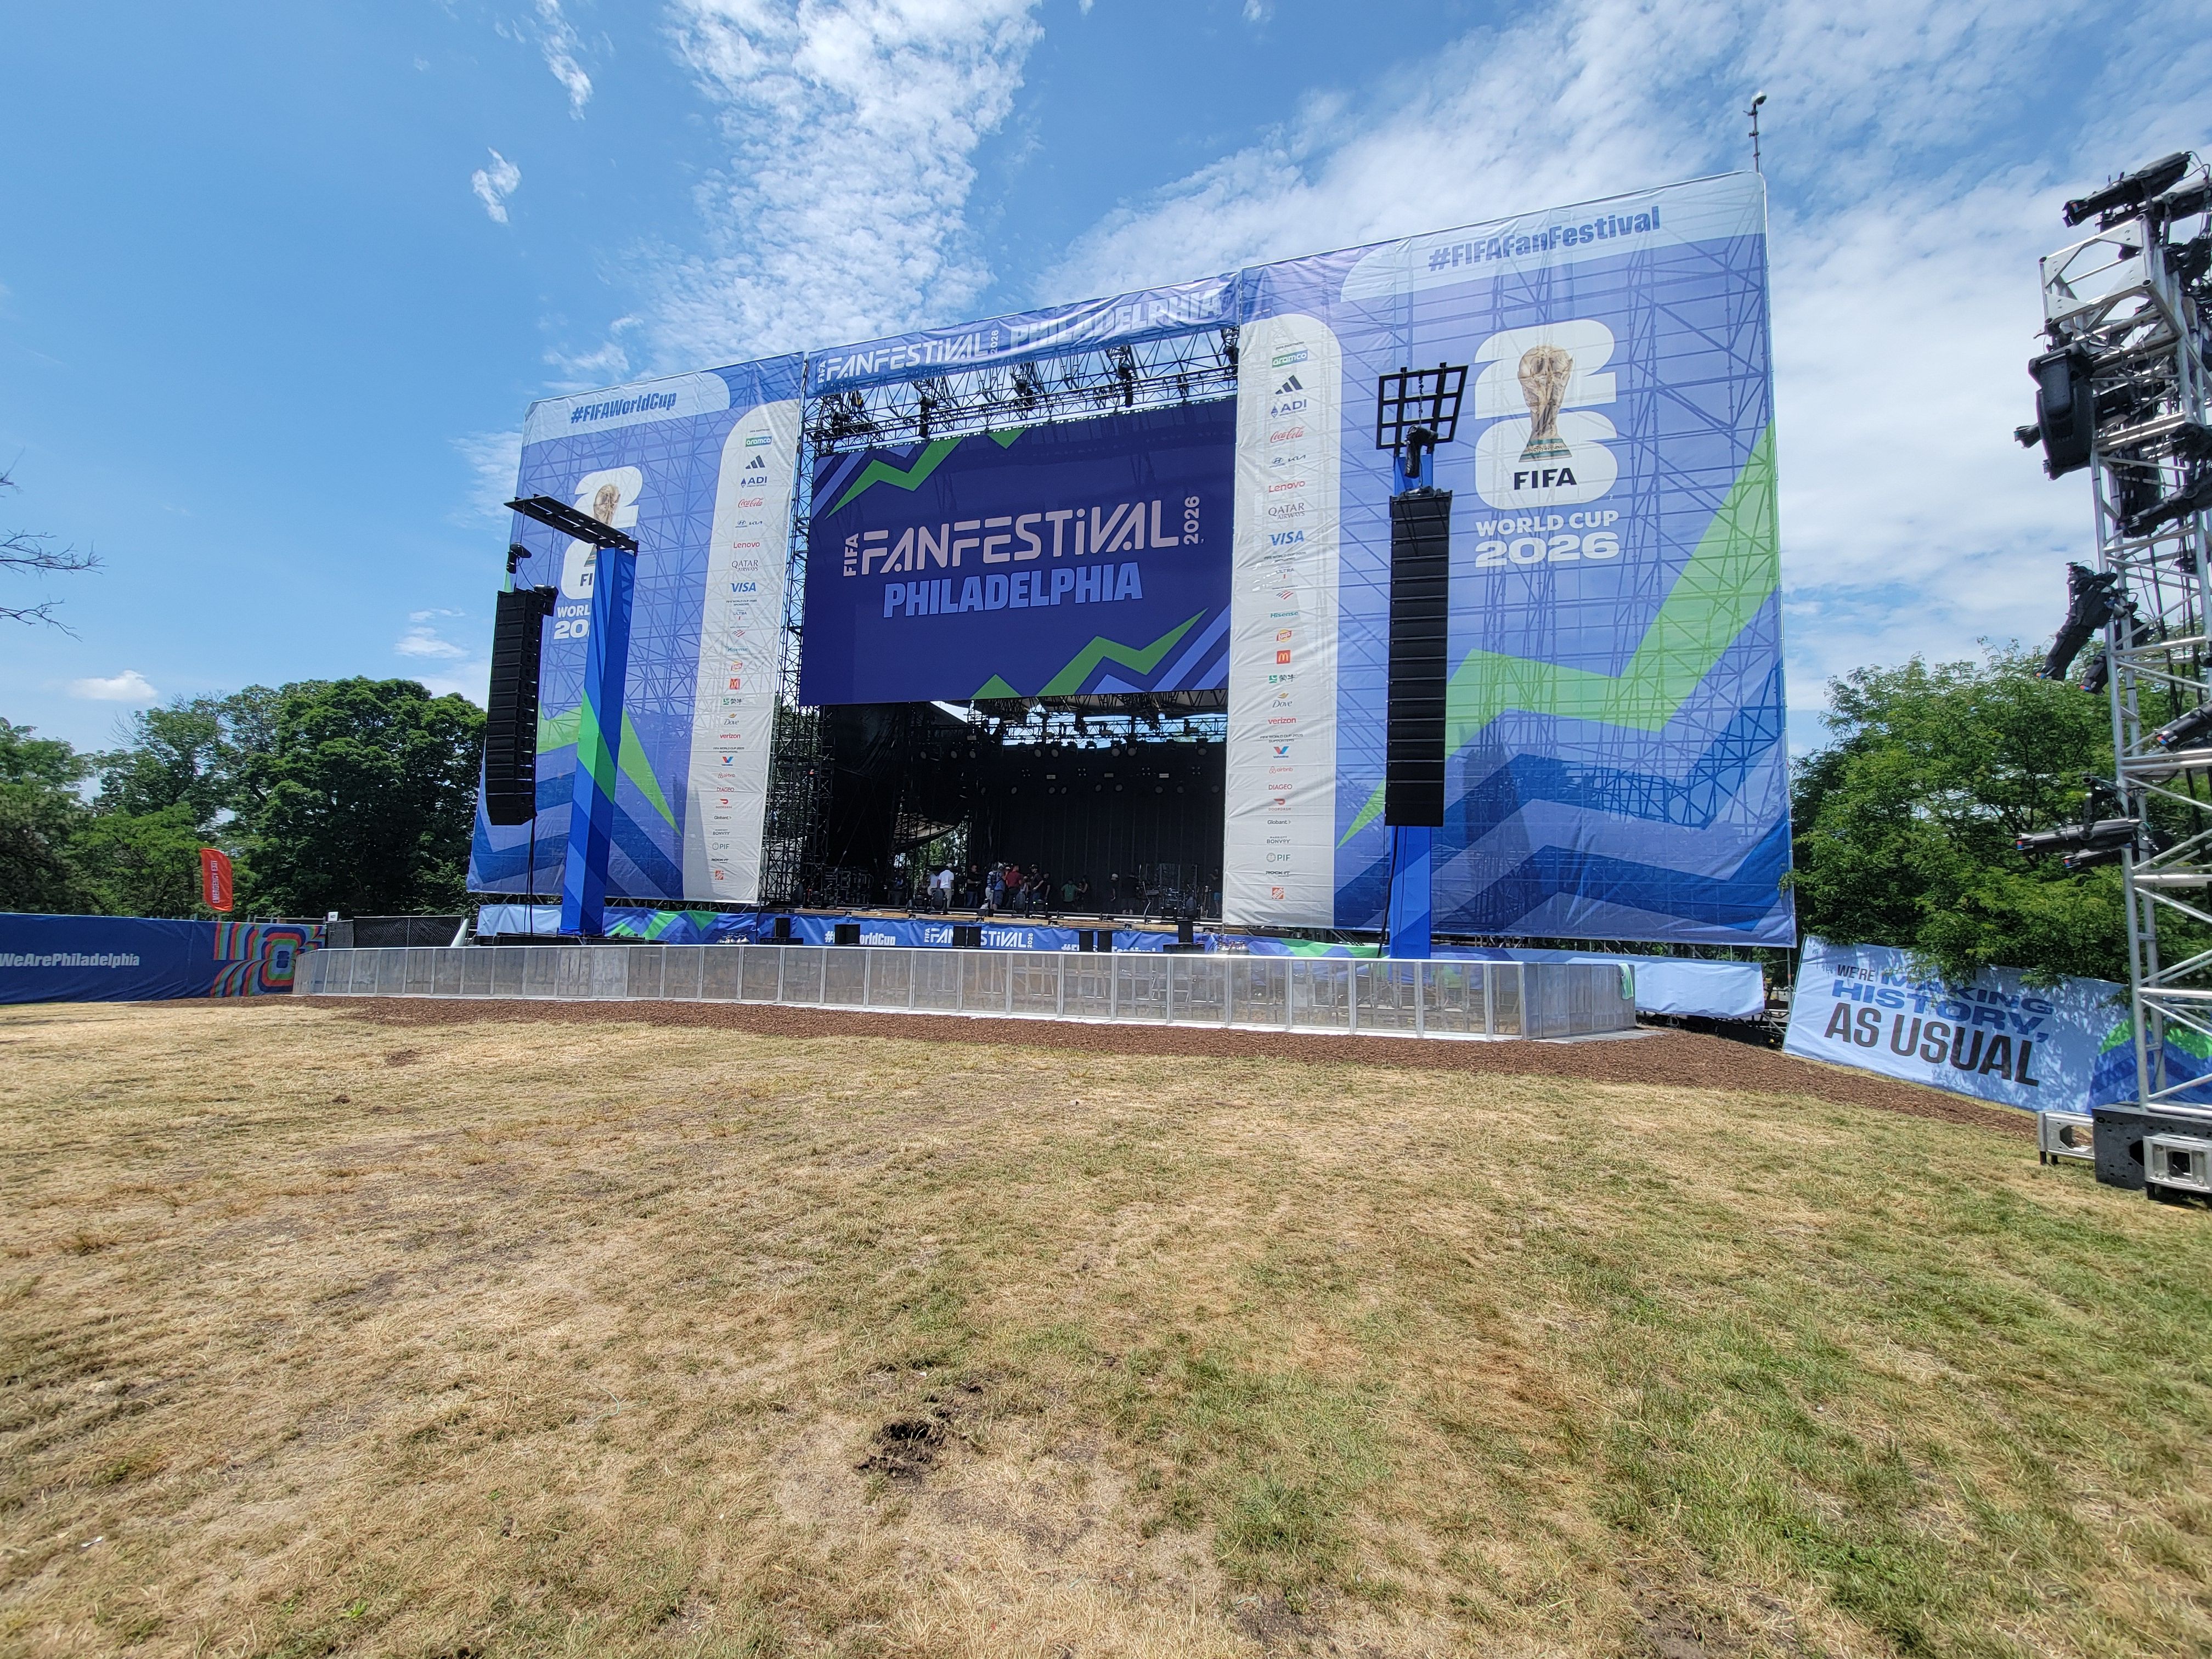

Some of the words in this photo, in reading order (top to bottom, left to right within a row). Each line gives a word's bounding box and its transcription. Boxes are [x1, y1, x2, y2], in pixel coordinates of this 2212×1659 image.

[1429, 206, 1659, 272] #FIFAFanFestival
[1011, 289, 1222, 352] PHILADELPHIA
[990, 329, 1000, 354] 2026
[1272, 352, 1307, 366] aramco
[571, 392, 677, 424] #FIFAWorldCup
[1280, 399, 1307, 413] ADI
[748, 476, 768, 485] ADI
[1268, 481, 1306, 493] Lenovo
[1514, 467, 1577, 490] FIFA
[1268, 503, 1305, 516] QATAR
[1277, 511, 1305, 520] AIRWAYS
[1476, 514, 1564, 537] WORLD
[1569, 510, 1619, 529] CUP
[843, 533, 859, 577] FIFA
[1183, 495, 1200, 545] 2026
[1268, 531, 1305, 546] VISA
[1475, 532, 1620, 568] 2026
[731, 560, 758, 568] QATAR
[580, 573, 594, 586] FI
[730, 582, 757, 592] VISA
[883, 562, 1143, 618] PHILADELPHIA
[557, 605, 590, 618] WORL
[554, 619, 590, 640] 20
[1272, 699, 1293, 708] Dove
[211, 872, 220, 904] EMERGENCY
[1837, 963, 1875, 982] WE'RE
[1824, 1002, 1881, 1048] AS
[1889, 1014, 2039, 1087] USUAL
